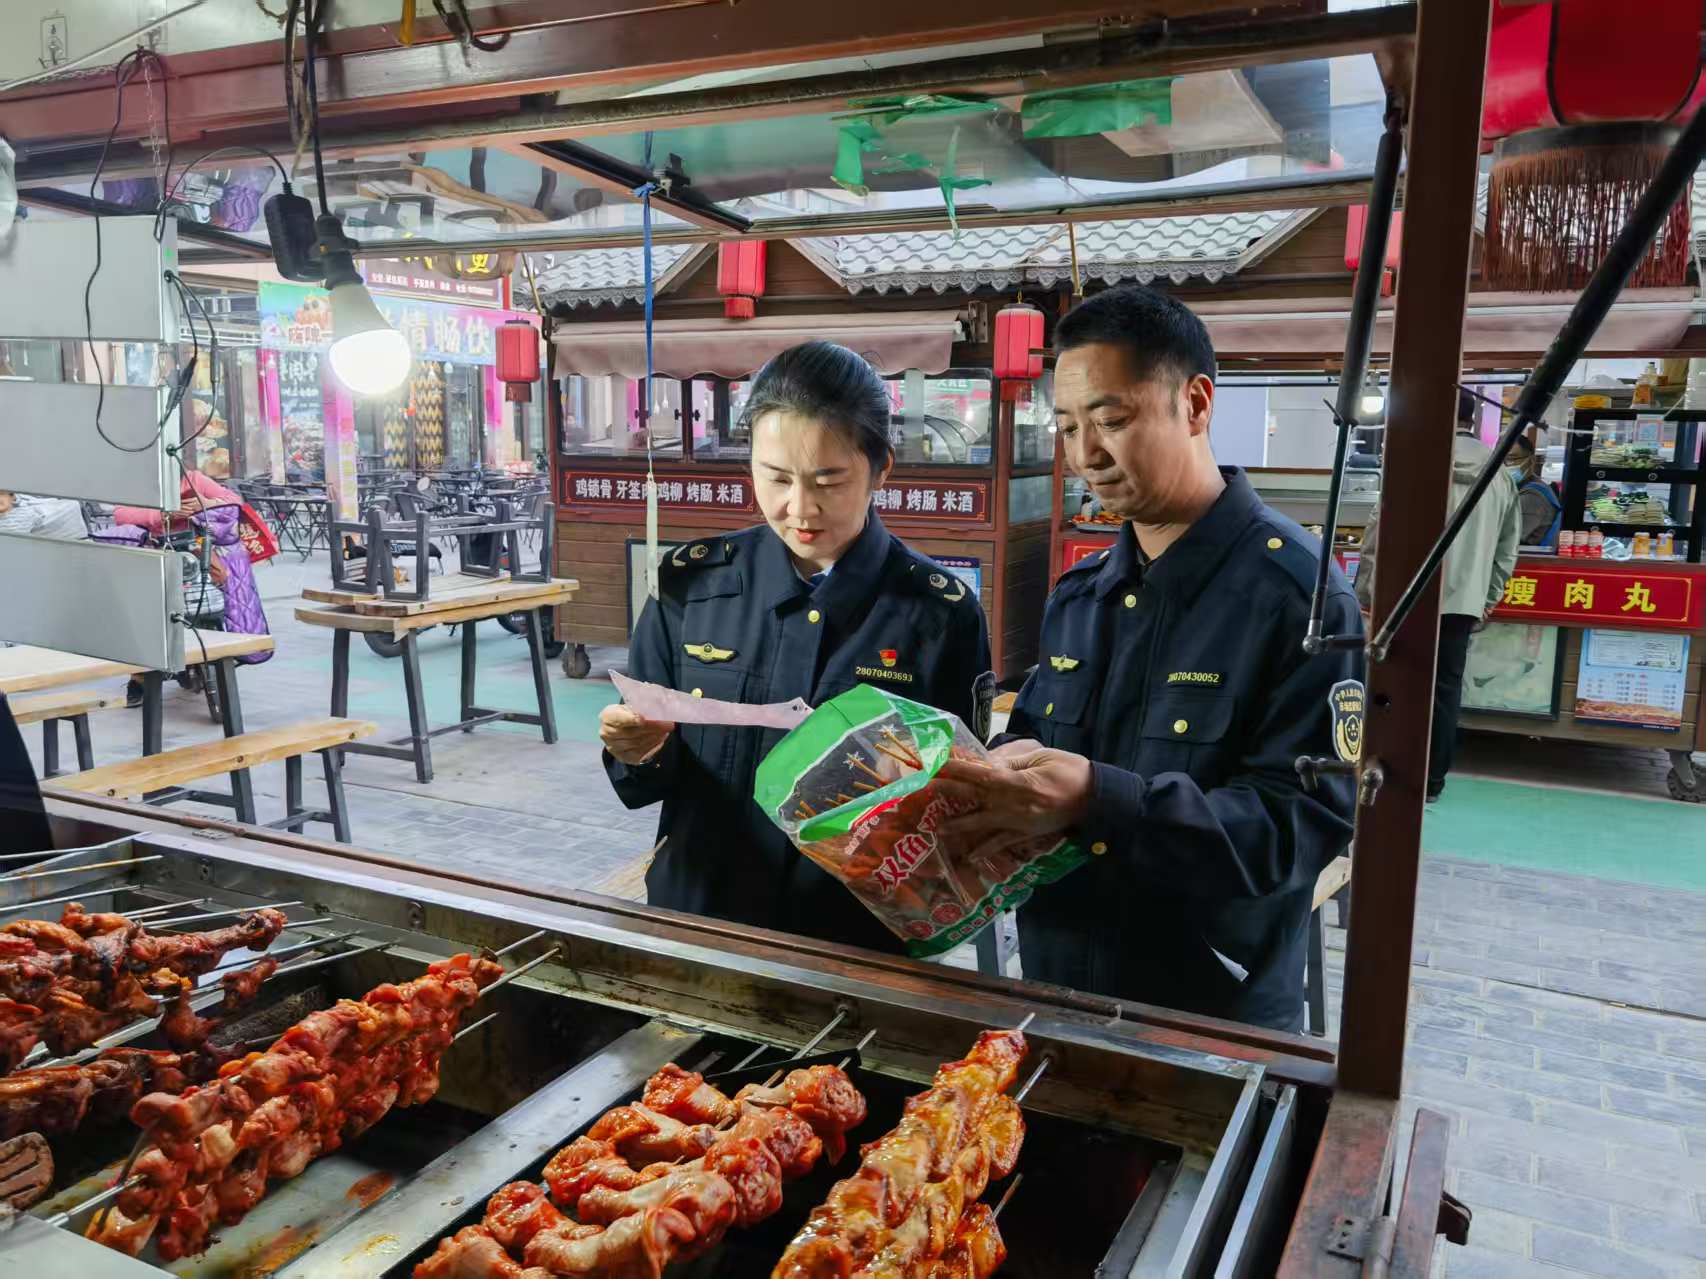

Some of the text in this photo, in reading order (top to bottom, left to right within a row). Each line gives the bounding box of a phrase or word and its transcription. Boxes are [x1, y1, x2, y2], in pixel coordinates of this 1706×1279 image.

[384, 303, 490, 354] 情畅饮
[575, 478, 612, 499] 鸡锁骨
[657, 480, 683, 502] 鸡柳
[687, 482, 713, 503] 烤肠
[716, 483, 743, 504] 米酒
[872, 487, 973, 512] 鸡柳 烤肠 米酒
[1504, 576, 1657, 613] 瘦肉丸
